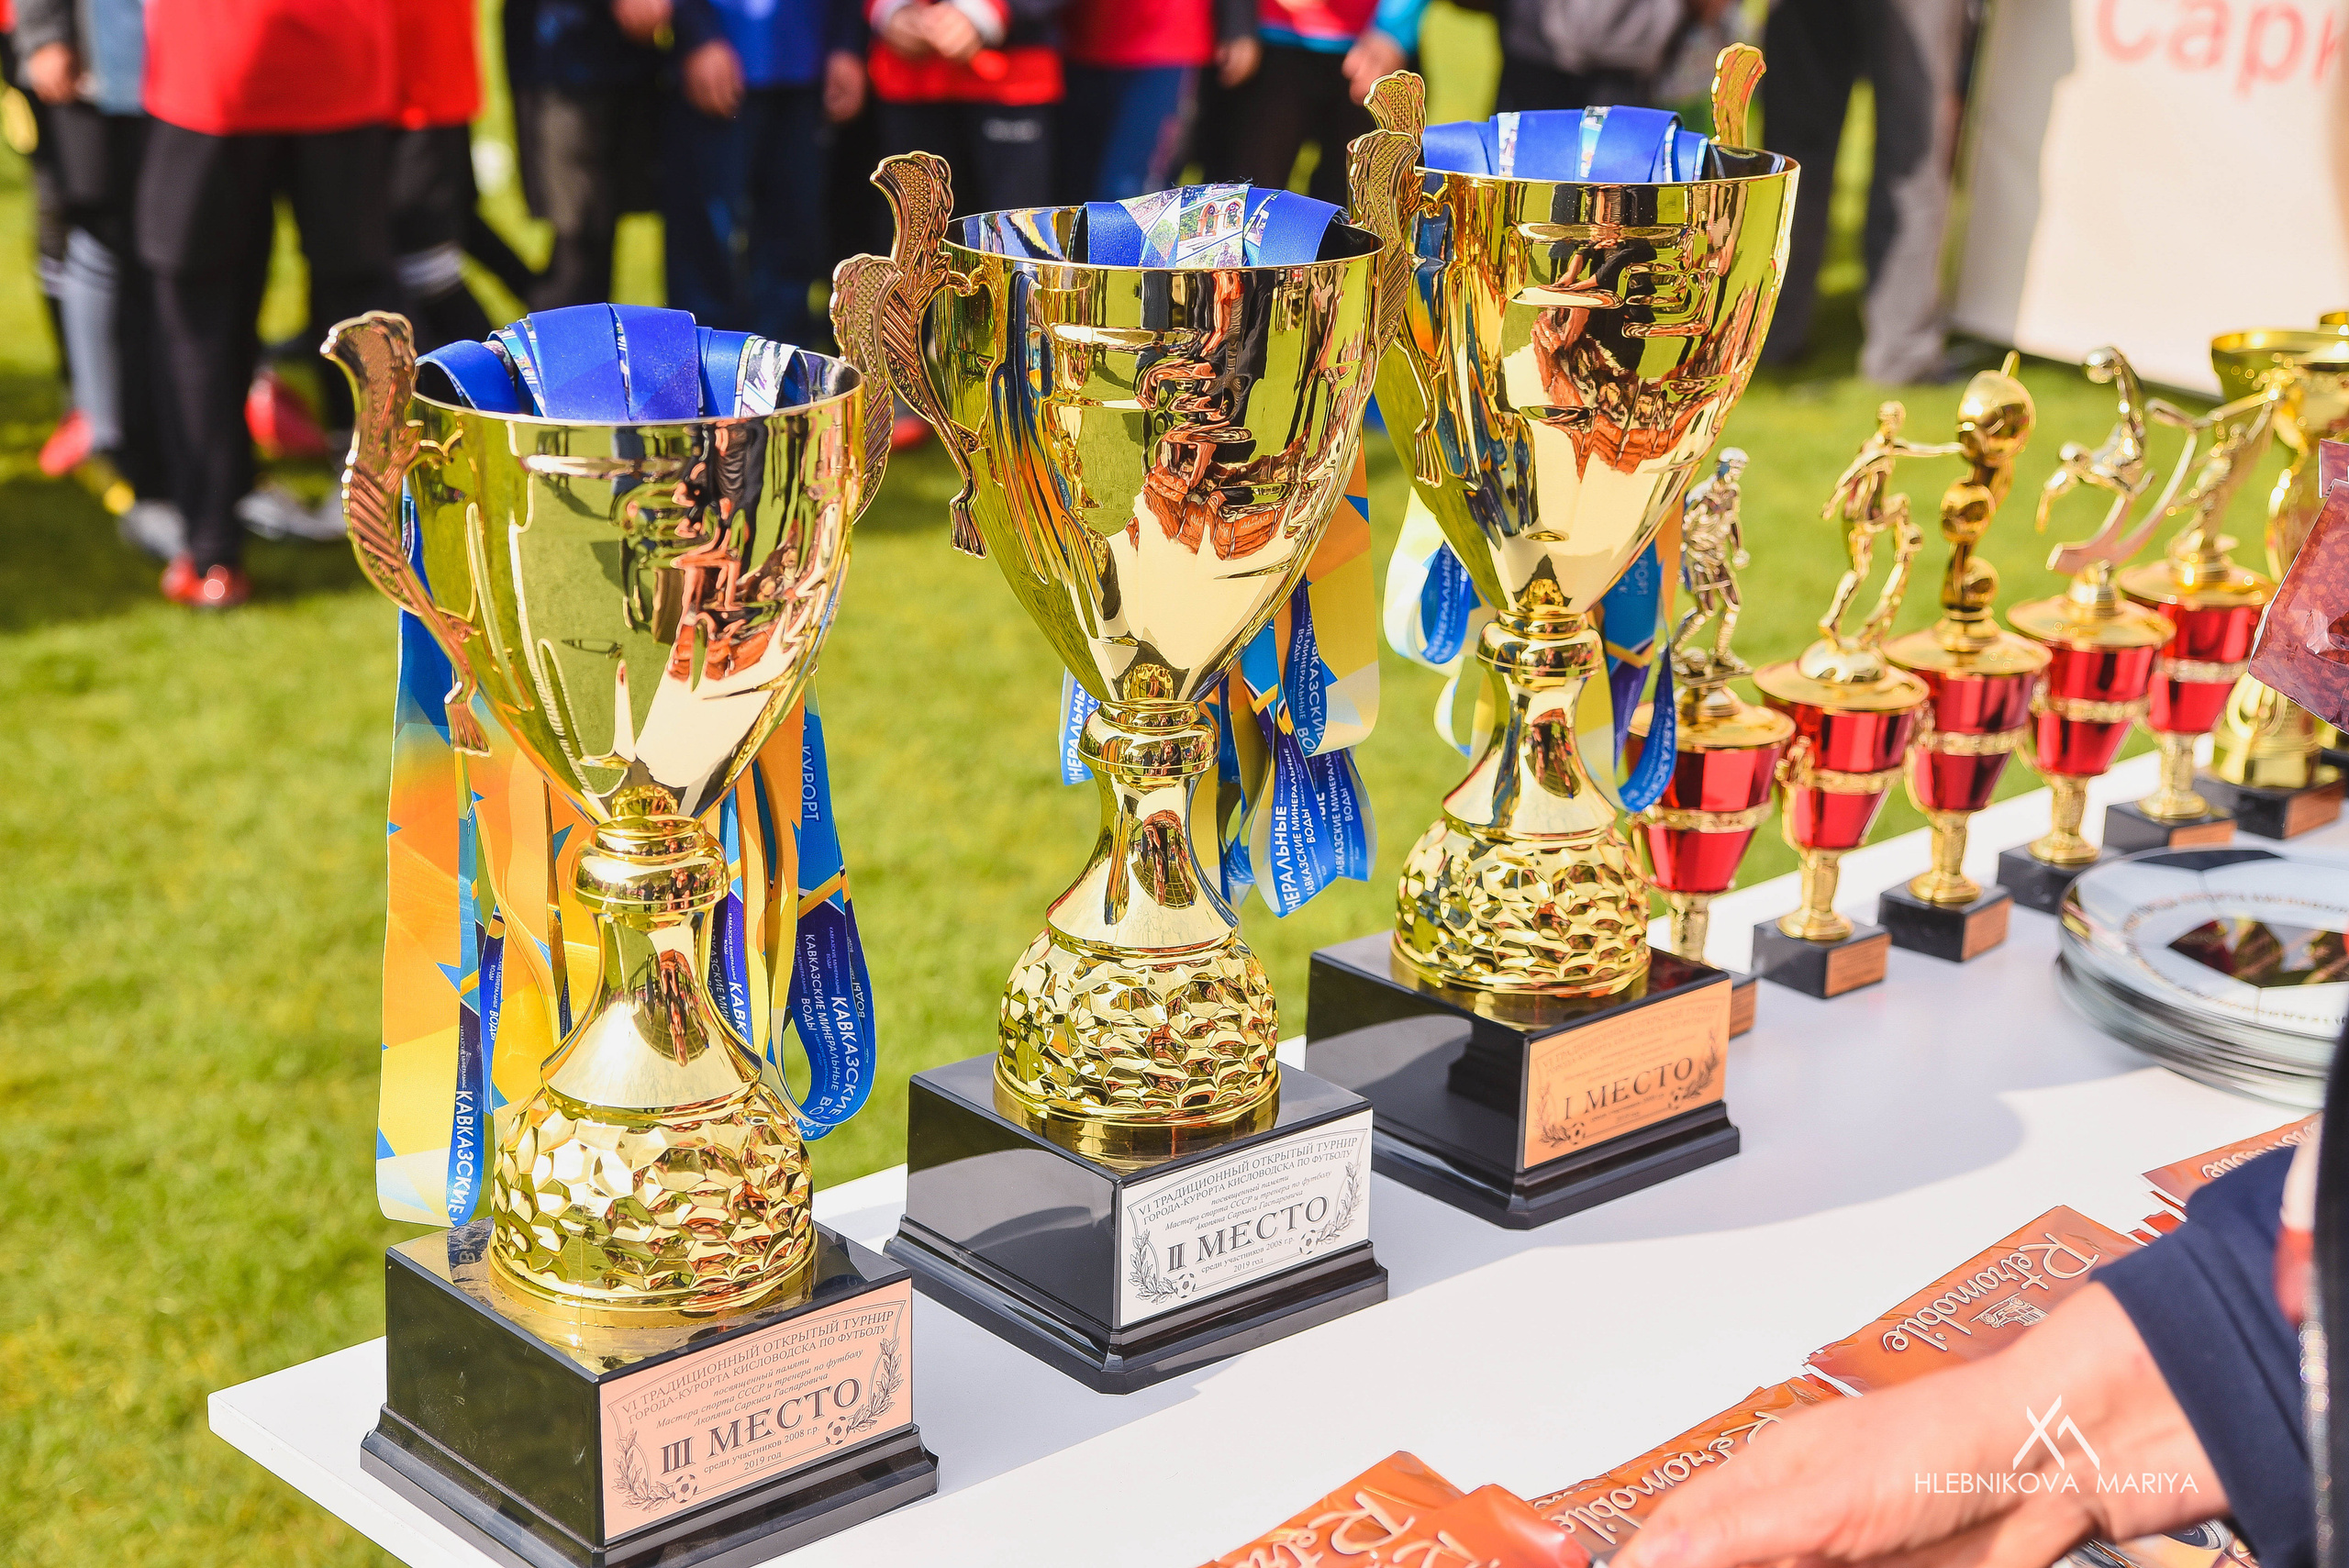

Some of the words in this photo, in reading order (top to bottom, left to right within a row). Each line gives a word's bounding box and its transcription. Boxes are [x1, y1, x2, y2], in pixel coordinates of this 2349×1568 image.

[1293, 628, 1305, 662] ВОДЫ
[802, 745, 820, 822] КУРОРТ
[1284, 748, 1300, 831] МИНЕРАЛЬНЫЕ
[1340, 787, 1353, 822] ВОДЫ
[1301, 808, 1317, 843] ВОДЫ
[1275, 806, 1302, 913] НЕРАЛЬНЫЕ
[801, 997, 817, 1031] ВОДЫ
[805, 934, 826, 1010] КАВКАЗСКИЕ
[817, 1012, 841, 1092] МИНЕРАЛЬНЫЕ
[852, 982, 866, 1018] ВОДЫ
[828, 996, 860, 1116] КАВКАЗСКИЕ
[1584, 1057, 1694, 1115] МЕСТО
[447, 1090, 474, 1214] КАВКАЗСКИЕ
[1139, 1204, 1151, 1216] VI
[1153, 1161, 1249, 1209] ТРАДИЦИОННЫЙ
[1252, 1142, 1313, 1169] ОТКРЫТЫЙ
[1317, 1138, 1358, 1152] ТУРНИР
[1143, 1184, 1226, 1225] ГОРОДА-КУРОРТА
[1228, 1162, 1295, 1188] КИСЛОВОДСКА
[1297, 1157, 1309, 1167] ПО
[1311, 1150, 1353, 1163] ФУТБОЛУ
[1164, 1215, 1199, 1230] Мастера
[1200, 1206, 1228, 1220] спорта
[1230, 1195, 1253, 1209] СССР
[1260, 1184, 1290, 1200] тренера
[1301, 1171, 1332, 1187] футболу
[1195, 1217, 1226, 1231] Акопяна
[1227, 1207, 1258, 1221] Саркиса
[1259, 1190, 1303, 1210] Гаспаровича
[1211, 1184, 1260, 1206] посвященный
[1261, 1175, 1289, 1189] памяти
[1167, 1241, 1186, 1273] II
[1195, 1195, 1330, 1264] МЕСТО
[1201, 1261, 1223, 1273] среди
[1224, 1246, 1264, 1268] участников
[1265, 1239, 1283, 1251] 2008
[1284, 1236, 1295, 1247] г.р.
[1233, 1261, 1251, 1273] 2019
[1252, 1257, 1264, 1267] год
[1882, 1232, 2100, 1351] Retromobile
[622, 1399, 637, 1414] VI
[640, 1344, 760, 1405] ТРАДИЦИОННЫЙ
[763, 1319, 840, 1353] ОТКРЫТЫЙ
[842, 1310, 895, 1330] ТУРНИР
[629, 1372, 730, 1424] ГОРОДА-КУРОРТА
[733, 1342, 817, 1377] КИСЛОВОДСКА
[819, 1336, 835, 1349] ПО
[838, 1324, 888, 1342] ФУТБОЛУ
[656, 1409, 698, 1429] Мастера
[700, 1396, 735, 1413] спорта
[738, 1383, 765, 1400] СССР
[774, 1368, 811, 1385] тренера
[813, 1364, 824, 1373] по
[826, 1349, 863, 1370] футболу
[713, 1369, 774, 1397] посвященный
[775, 1358, 810, 1373] памяти
[661, 1436, 696, 1476] III
[707, 1378, 863, 1460] МЕСТО
[694, 1408, 732, 1427] Акопяна
[734, 1395, 772, 1413] Саркиса
[773, 1373, 829, 1398] Гаспаровича
[704, 1460, 730, 1473] среди
[731, 1440, 783, 1465] участников
[785, 1429, 805, 1443] 2008
[807, 1427, 820, 1438] г.р.
[743, 1456, 765, 1471] 2019
[767, 1451, 782, 1462] год
